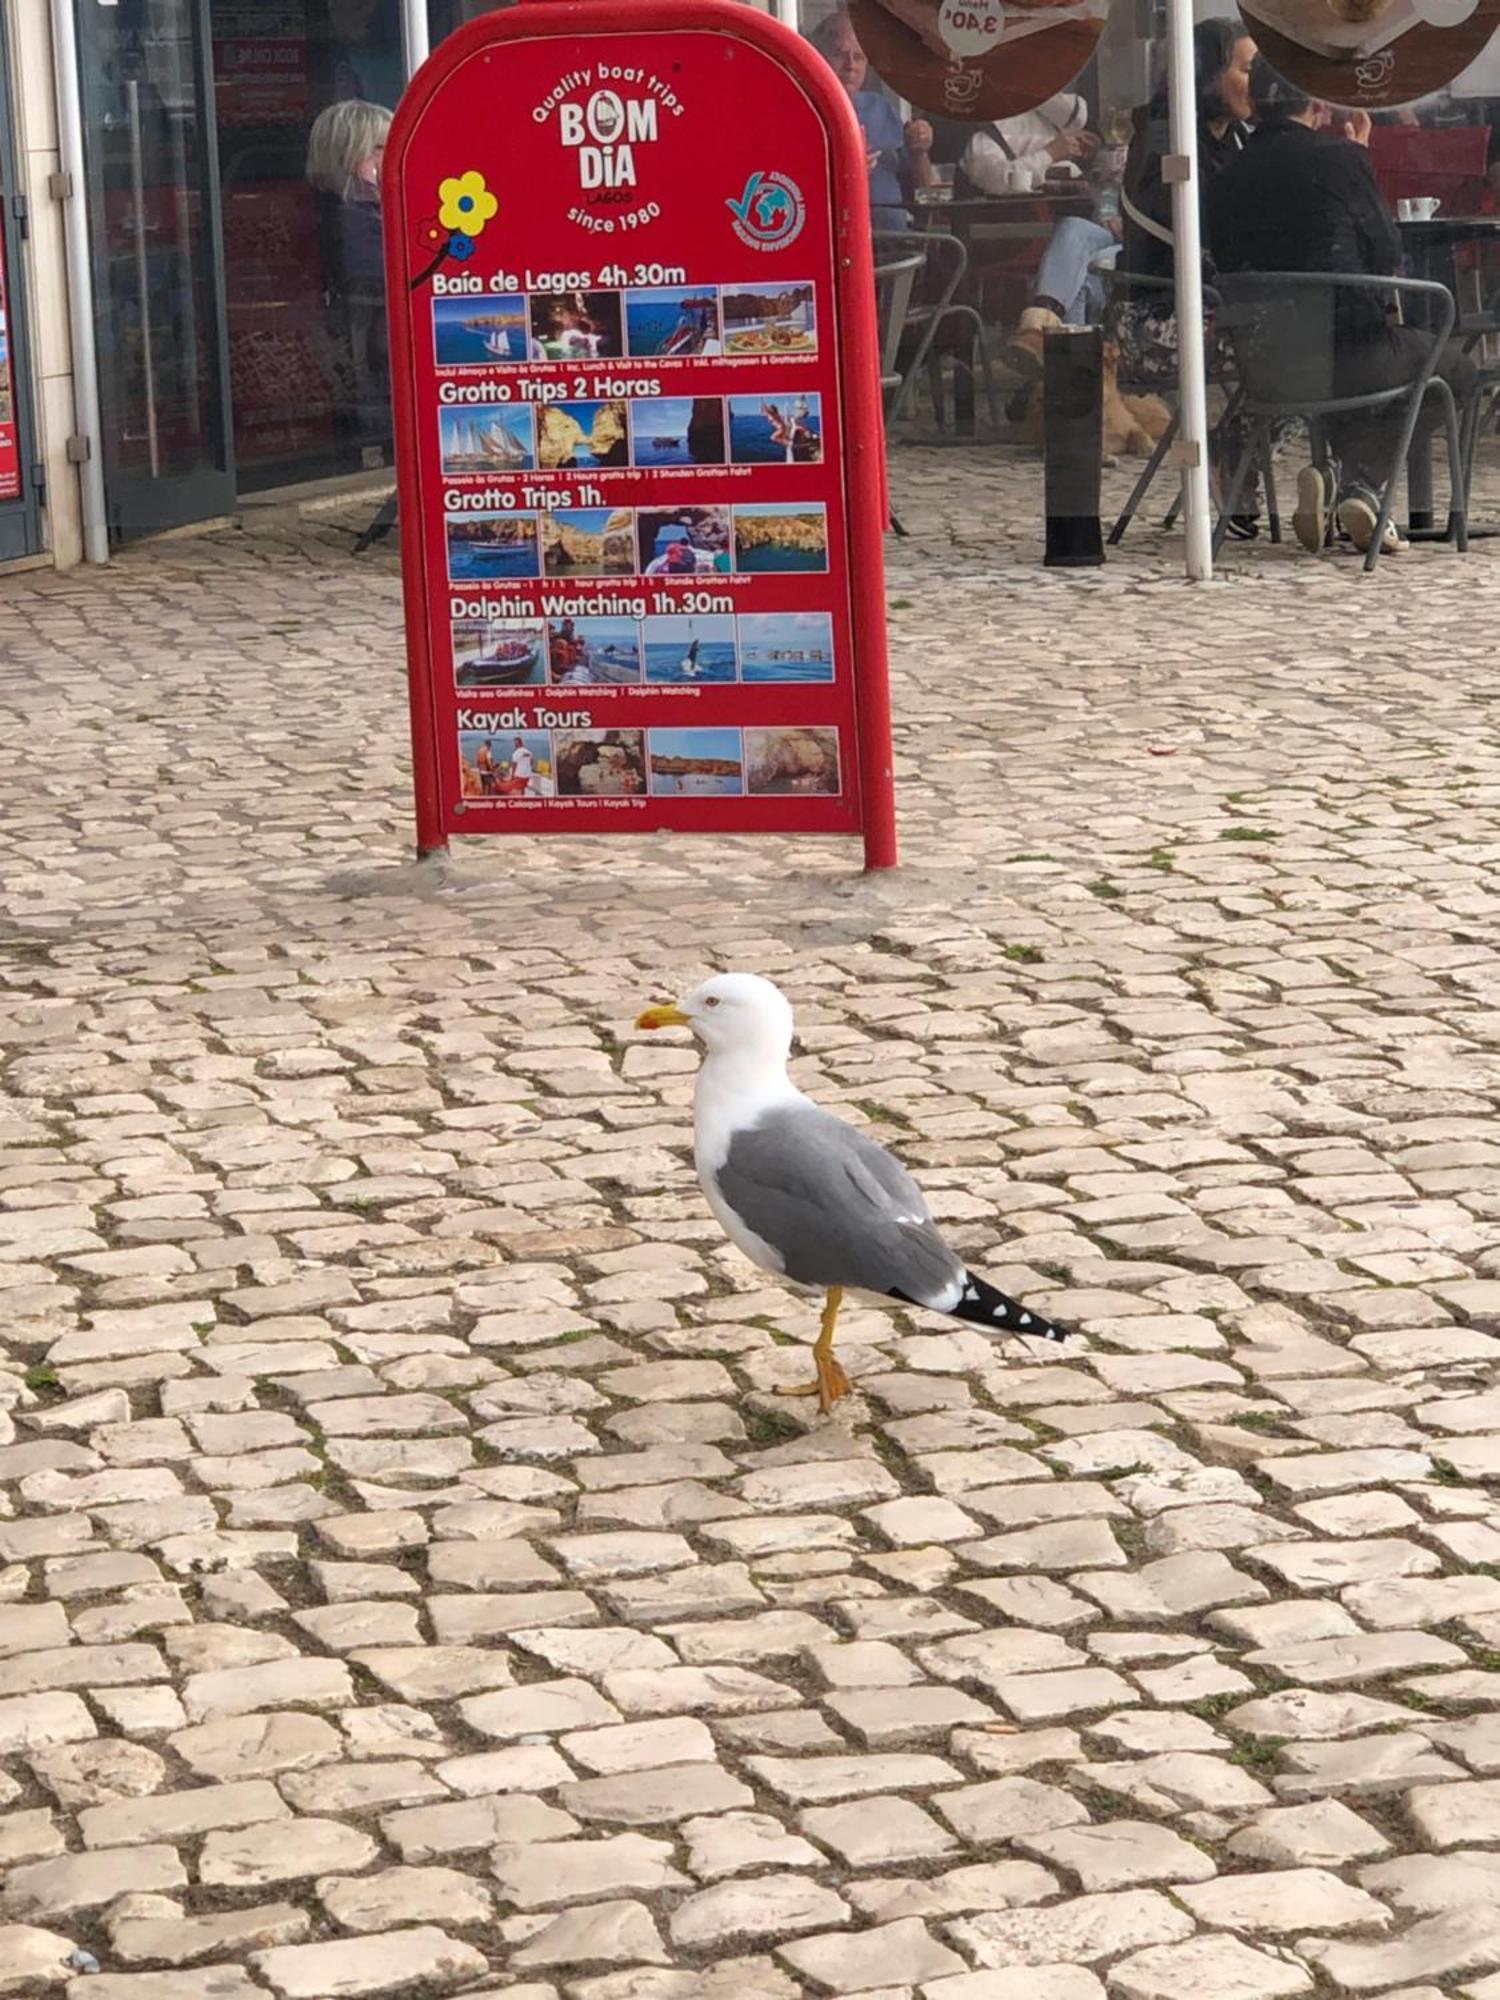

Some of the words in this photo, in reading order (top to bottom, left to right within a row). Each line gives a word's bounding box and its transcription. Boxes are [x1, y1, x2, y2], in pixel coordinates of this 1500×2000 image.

[532, 69, 591, 123] Quality
[598, 62, 644, 83] boat
[647, 75, 685, 117] trips
[559, 89, 658, 147] BOM
[567, 207, 615, 233] since
[618, 201, 661, 231] 1980
[432, 270, 483, 294] Baía
[490, 269, 519, 292] de
[525, 269, 591, 294] Lagos
[597, 264, 685, 287] 4h.30m
[439, 381, 511, 403] Grotto
[517, 378, 567, 403] Trips
[573, 380, 587, 398] 2
[594, 377, 662, 397] Horas
[444, 488, 517, 511] Grotto
[521, 485, 572, 511] Trips
[577, 484, 607, 506] 1h.
[450, 595, 535, 621] Dolphin
[541, 593, 646, 620] Watching
[652, 592, 734, 614] 1h.30m
[546, 688, 576, 699] Dolphin
[578, 687, 617, 699] Watching
[628, 687, 660, 698] Dolphin
[662, 687, 701, 698] Watching
[456, 707, 528, 734] Kayak
[533, 707, 592, 727] Tours
[549, 800, 575, 809] Kayak
[576, 799, 597, 808] Tours
[604, 800, 630, 809] Kayak
[631, 799, 647, 809] Trip
